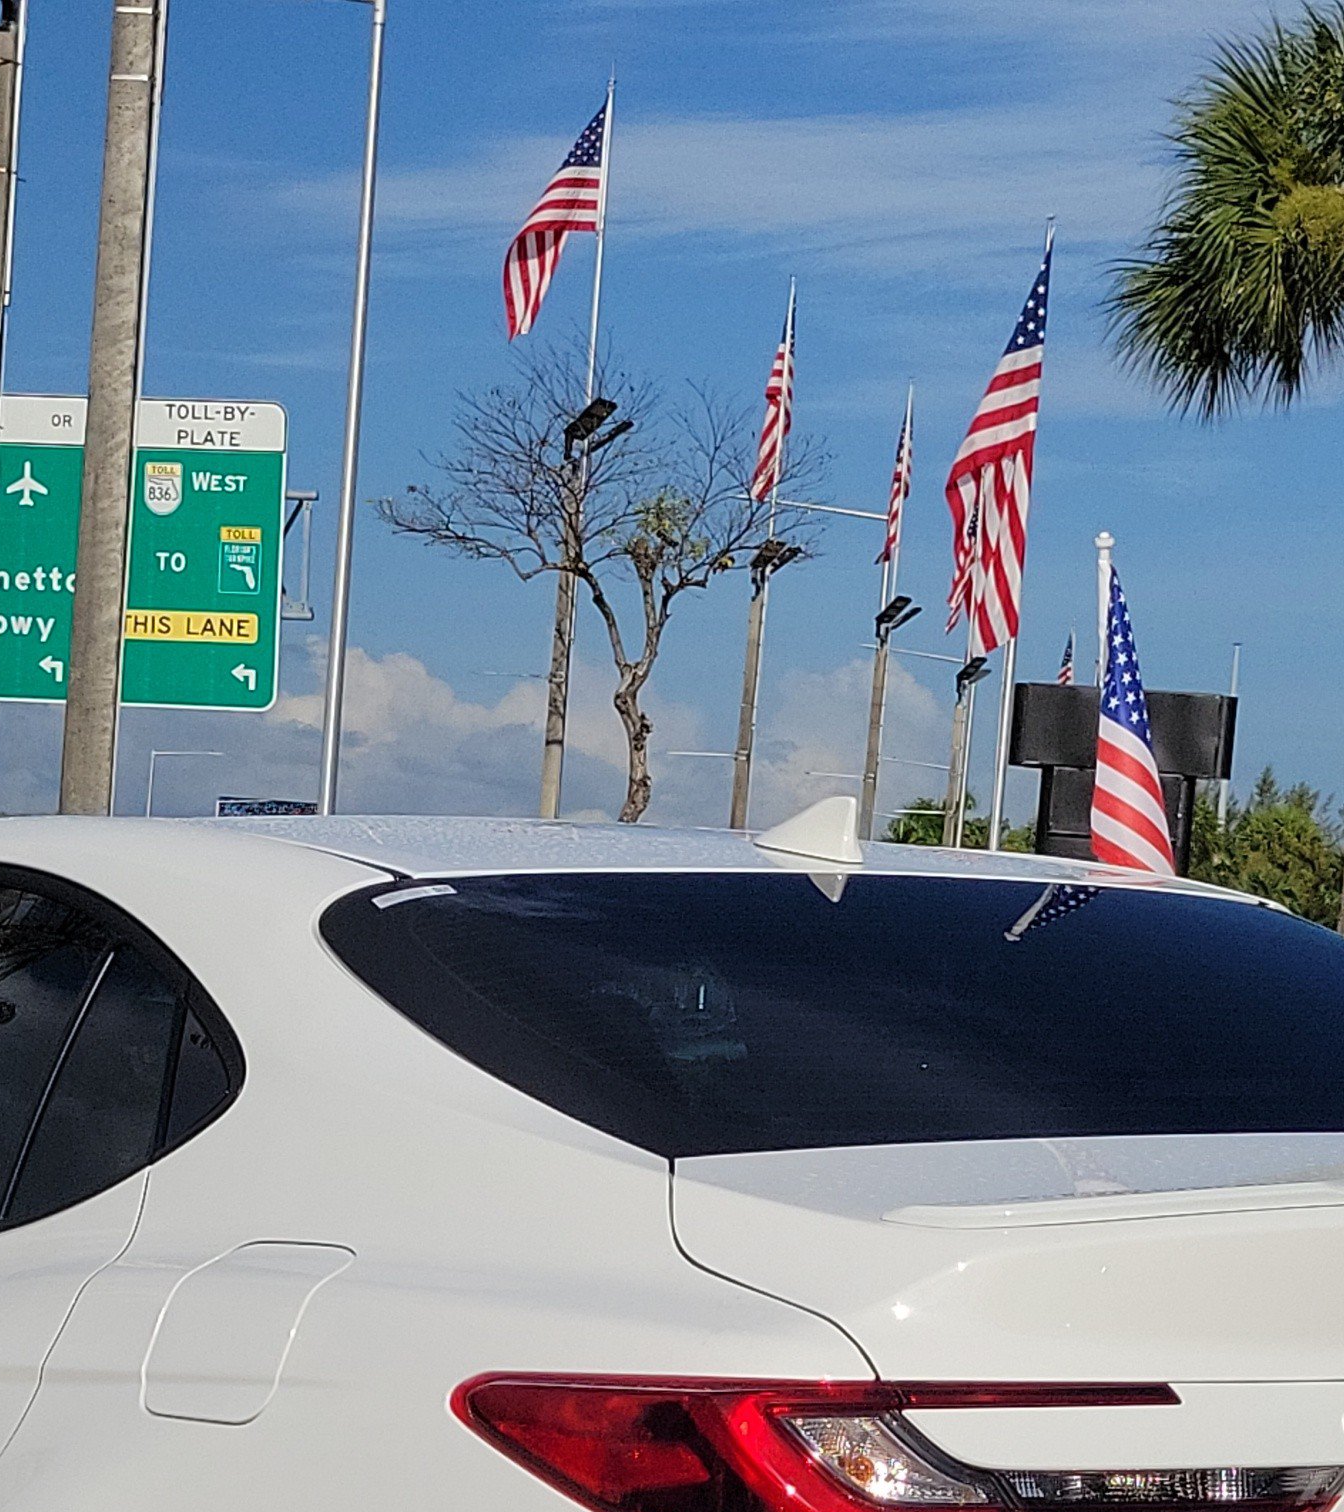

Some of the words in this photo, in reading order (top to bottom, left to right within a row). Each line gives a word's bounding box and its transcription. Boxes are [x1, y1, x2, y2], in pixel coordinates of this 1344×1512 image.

[52, 413, 73, 428] OR
[165, 403, 256, 422] TOLL-BY-
[176, 429, 242, 447] PLATE
[151, 465, 177, 475] TOLL
[191, 471, 248, 492] WEST
[148, 486, 172, 501] 836
[226, 529, 255, 540] TOLL
[155, 552, 187, 572] TO
[124, 614, 172, 634] THIS
[186, 616, 251, 638] LANE
